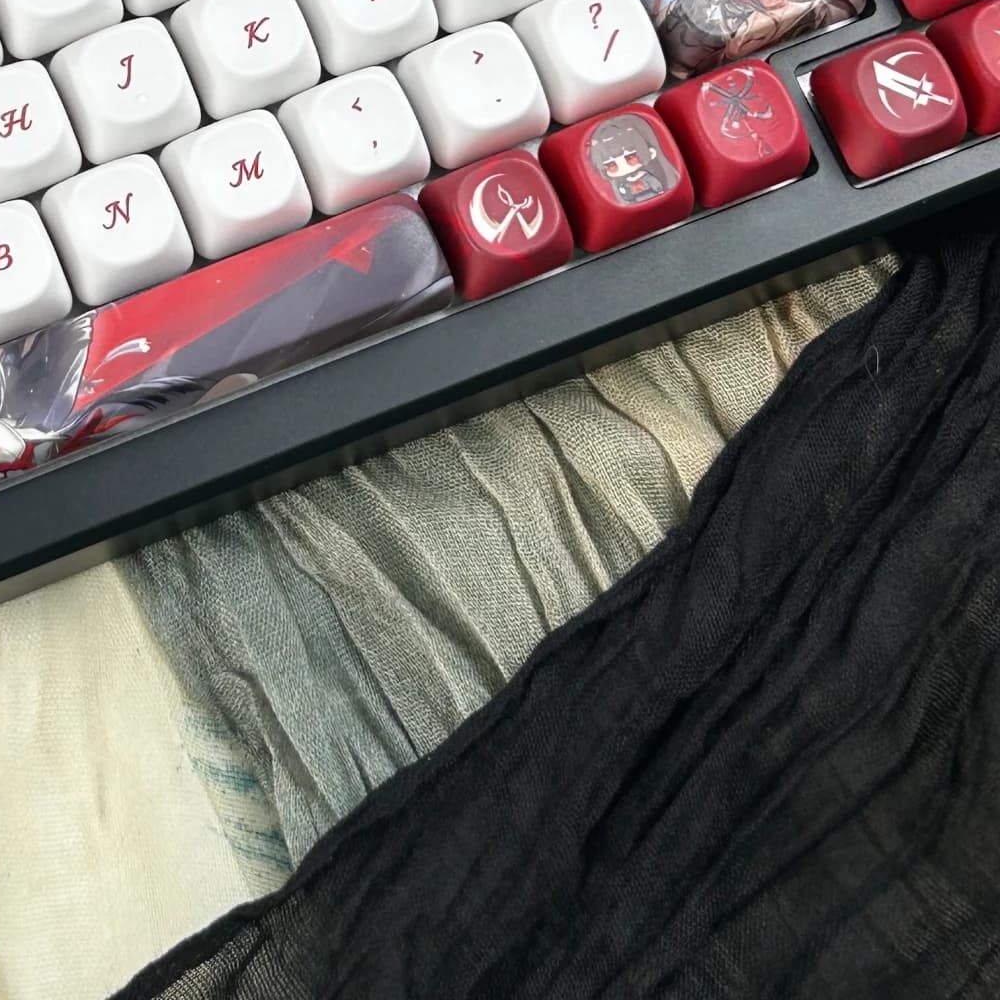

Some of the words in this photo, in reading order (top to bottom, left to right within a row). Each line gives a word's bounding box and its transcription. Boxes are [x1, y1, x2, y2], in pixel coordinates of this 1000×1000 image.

[243, 16, 270, 49] K
[588, 2, 603, 30] ?
[472, 50, 484, 65] >
[603, 28, 620, 63] /
[117, 54, 135, 90] J
[351, 96, 363, 112] <
[229, 151, 265, 188] M
[102, 192, 134, 230] N
